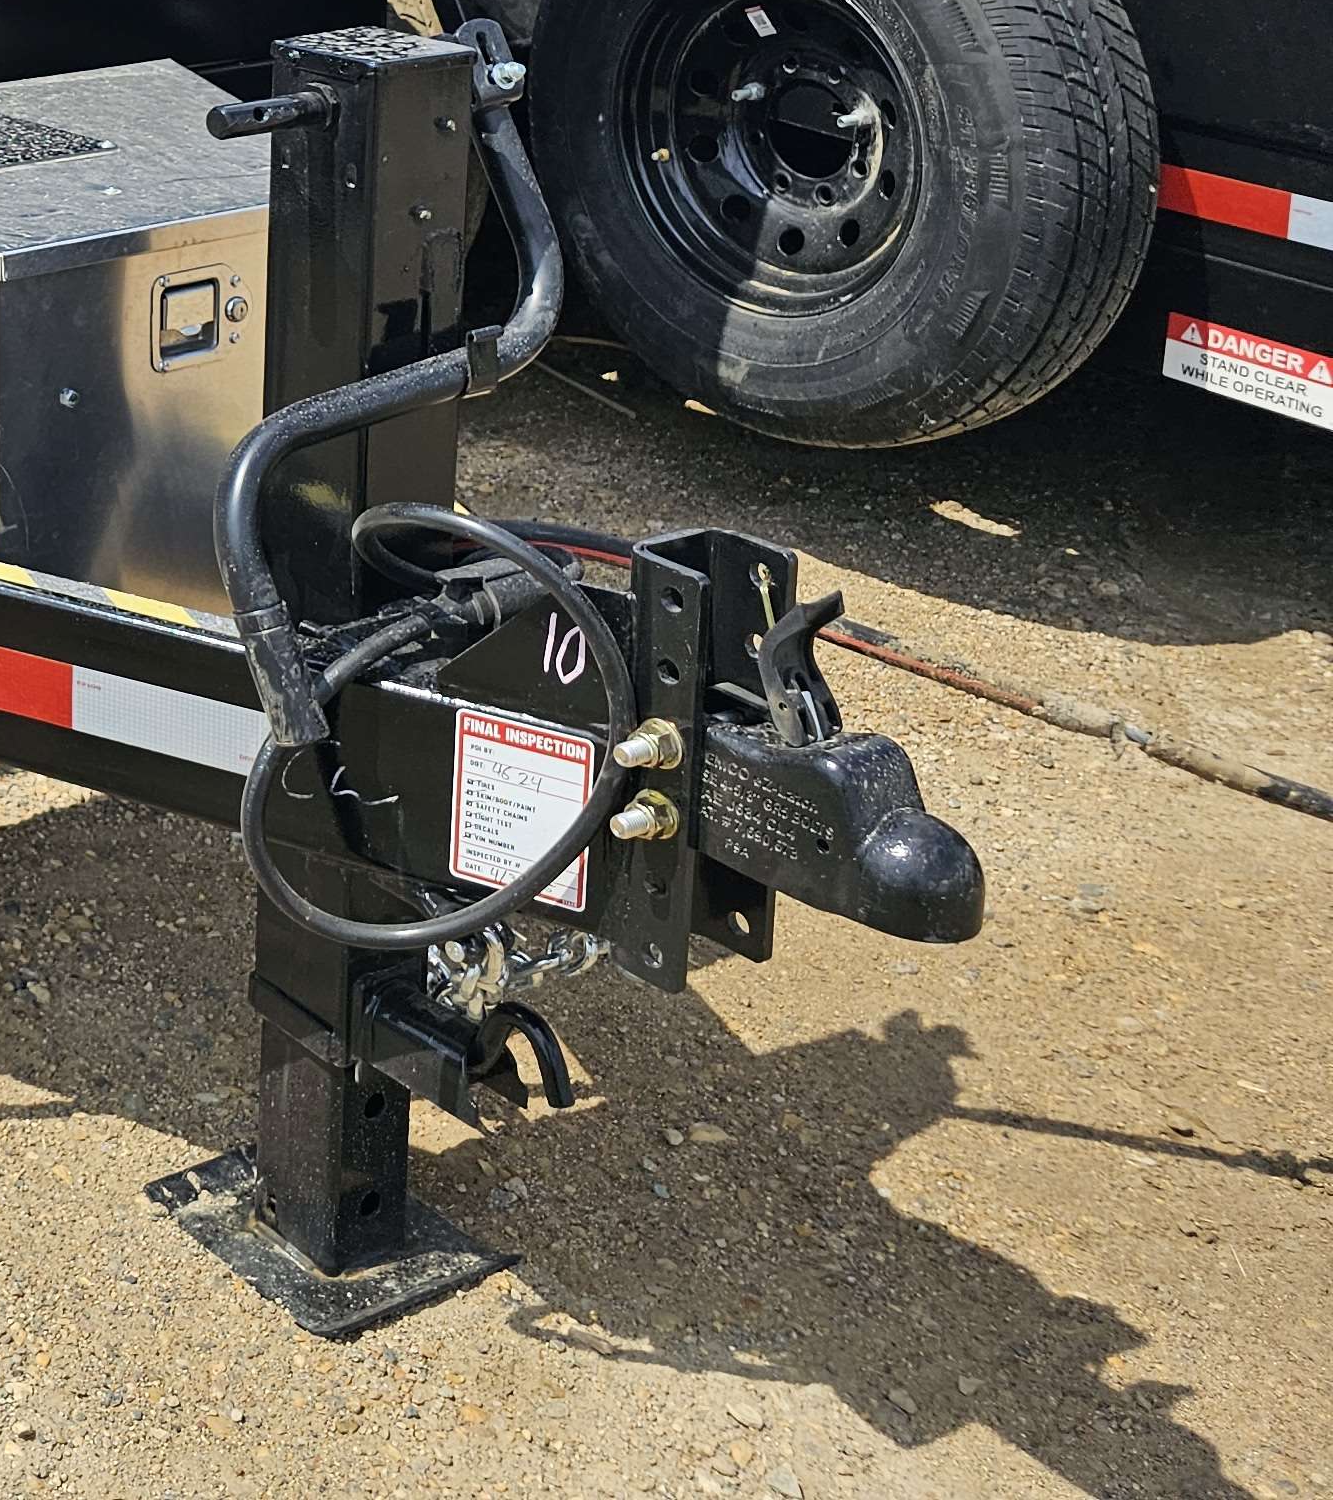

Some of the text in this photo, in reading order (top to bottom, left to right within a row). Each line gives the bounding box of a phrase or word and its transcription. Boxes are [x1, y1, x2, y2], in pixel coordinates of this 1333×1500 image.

[1208, 328, 1305, 374] DANGER
[1181, 363, 1324, 418] WHILE OPERATING
[1199, 353, 1309, 396] STAND CLEAR
[543, 612, 586, 685] 10
[463, 716, 587, 760] FINAL INSPECTION
[476, 802, 528, 822] SAFETY CHAINS
[466, 848, 501, 863] INSPECTED
[488, 838, 515, 851] NUMBER
